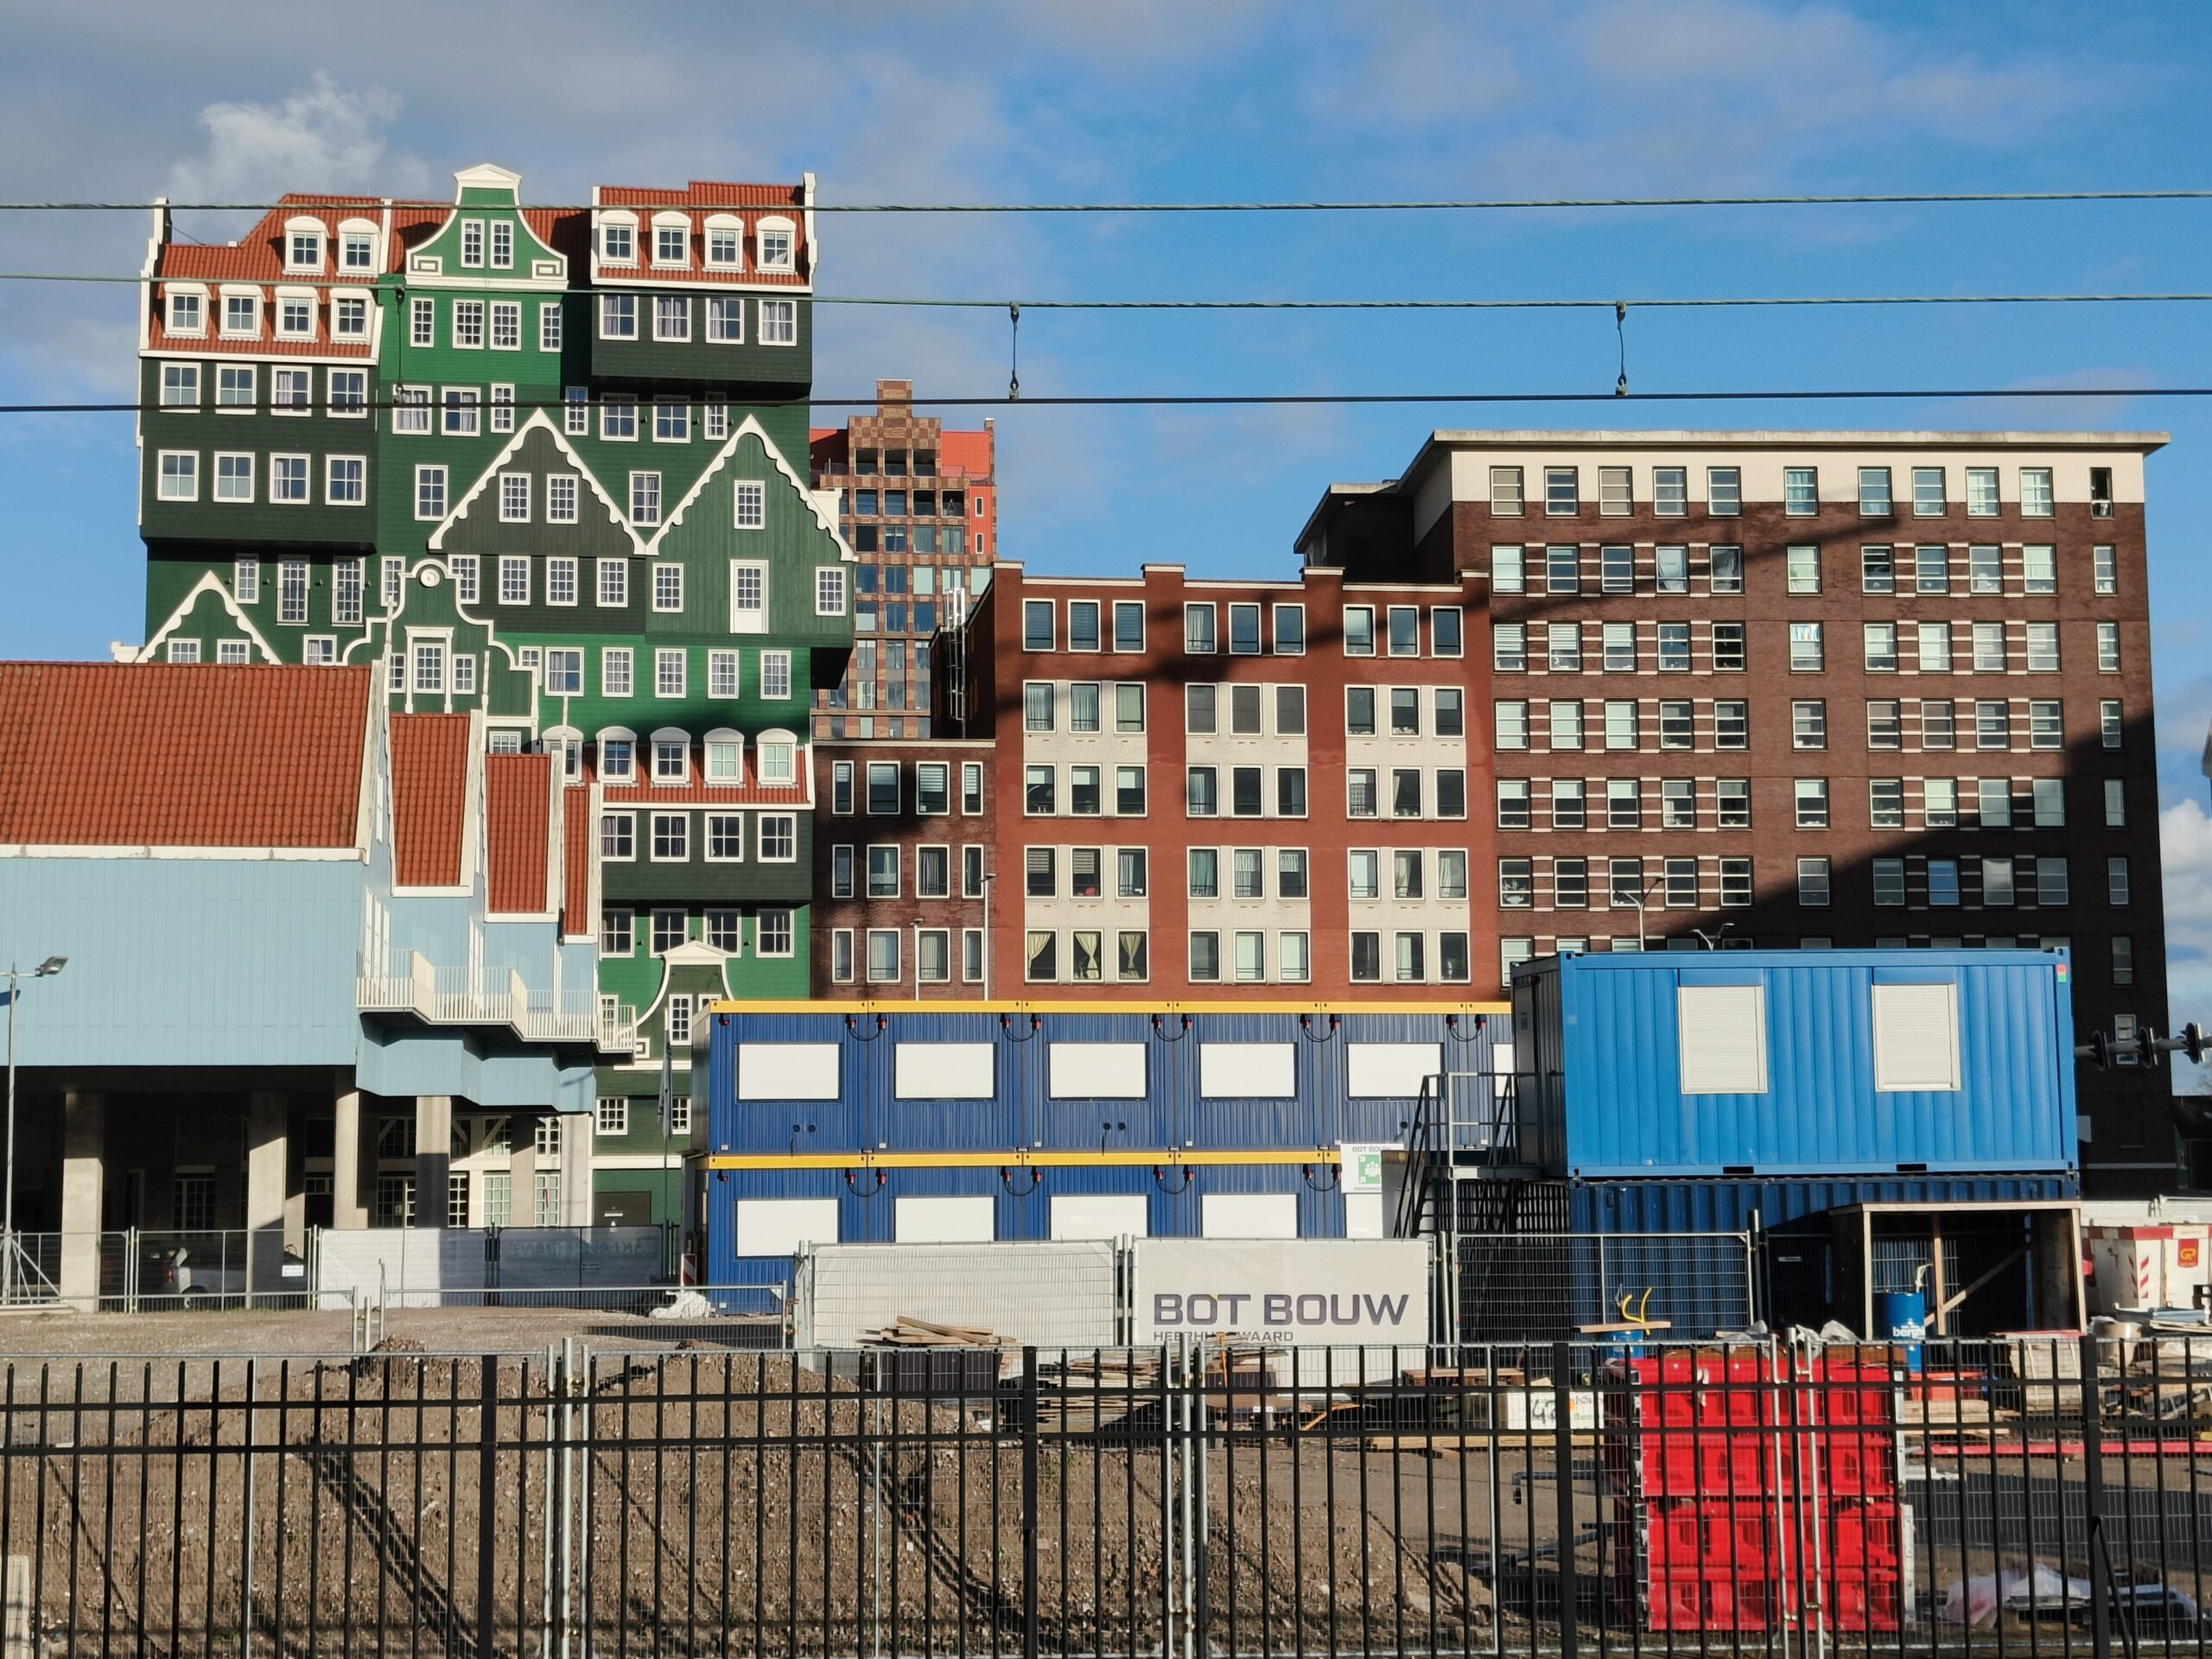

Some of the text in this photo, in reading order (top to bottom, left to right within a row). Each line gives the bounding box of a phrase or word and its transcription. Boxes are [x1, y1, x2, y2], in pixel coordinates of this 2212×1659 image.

[1154, 1294, 1409, 1325] BOT BOUW
[1154, 1332, 1294, 1342] HEERHAARD
